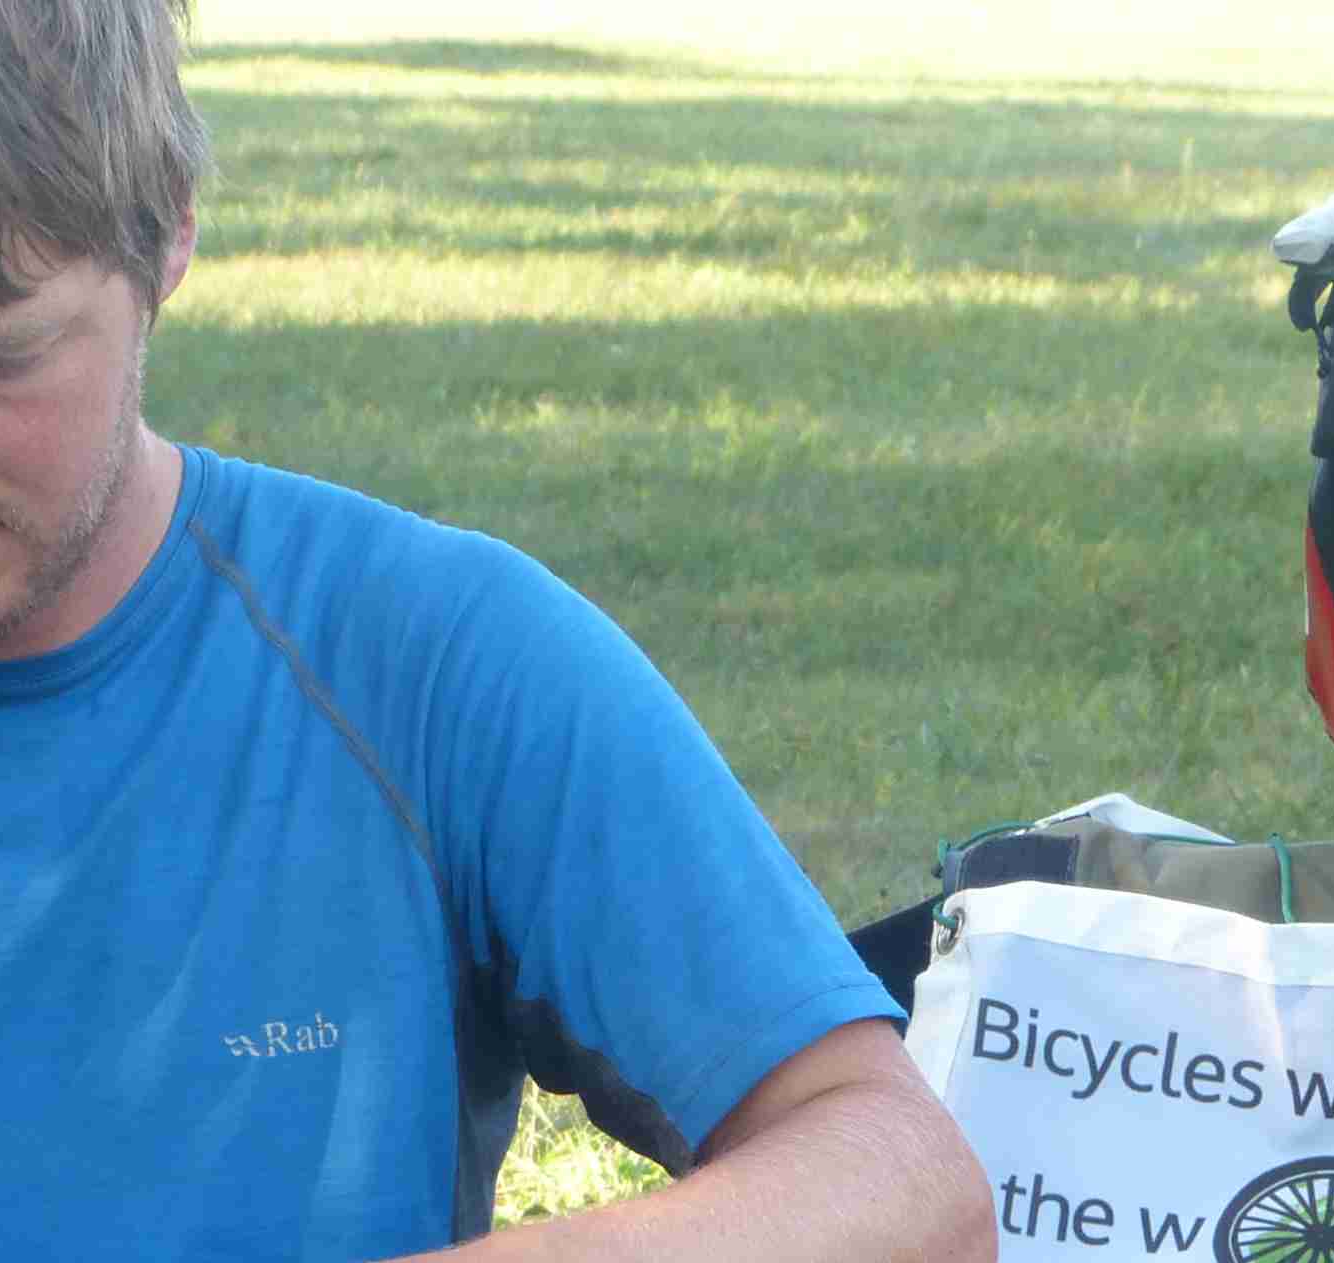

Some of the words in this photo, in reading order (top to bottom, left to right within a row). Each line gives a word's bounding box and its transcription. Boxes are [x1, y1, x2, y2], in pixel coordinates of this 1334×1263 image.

[261, 1009, 339, 1054] Rab
[972, 997, 1265, 1109] Bicycles
[1000, 1173, 1115, 1246] the
